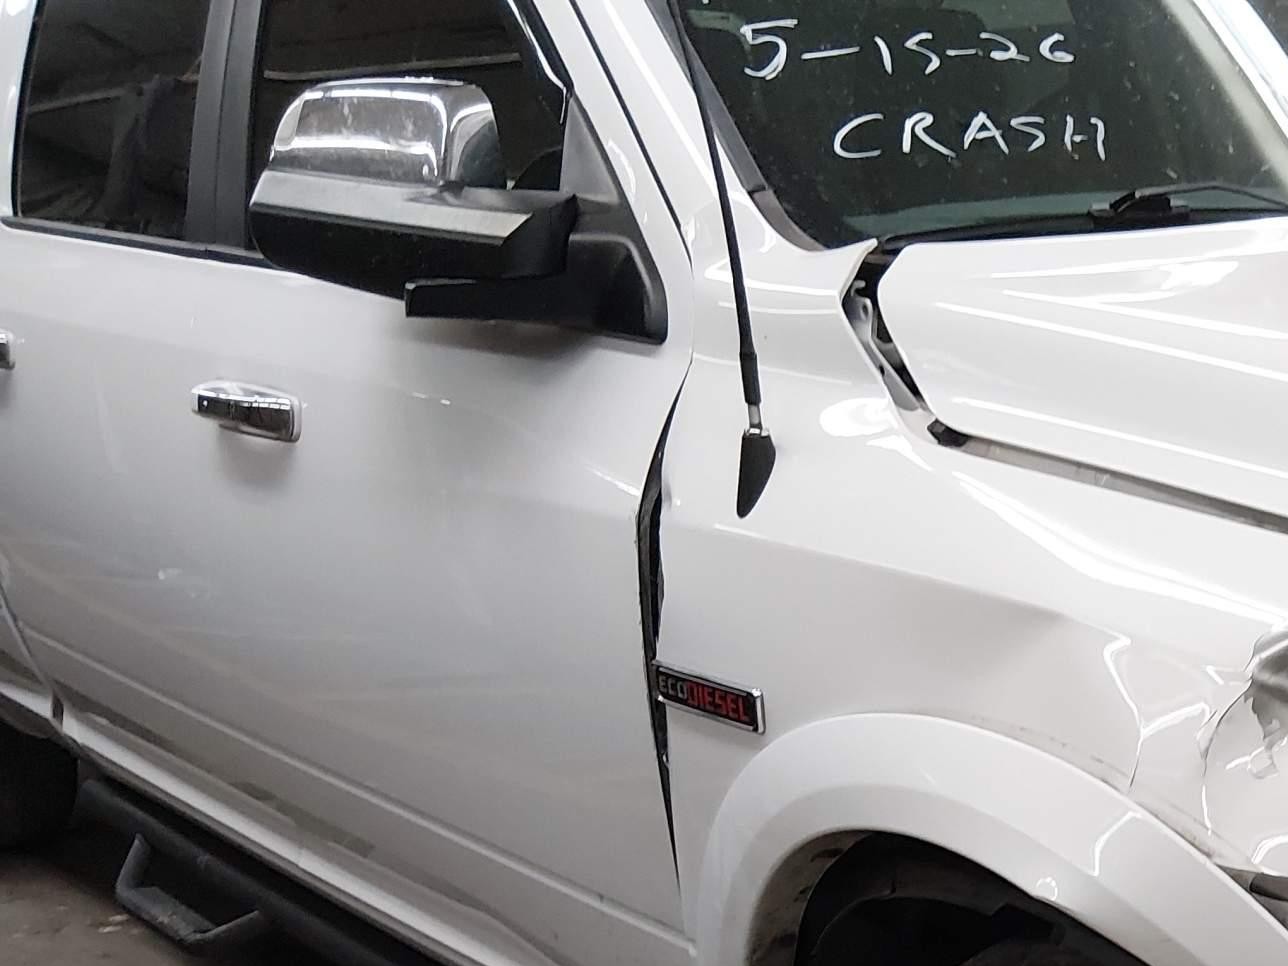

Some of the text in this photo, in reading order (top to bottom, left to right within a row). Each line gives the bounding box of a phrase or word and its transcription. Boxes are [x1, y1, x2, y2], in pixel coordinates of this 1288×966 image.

[740, 18, 1075, 81] 5-15-26
[832, 111, 1106, 161] CRASH
[658, 673, 752, 721] ECODIESEL
